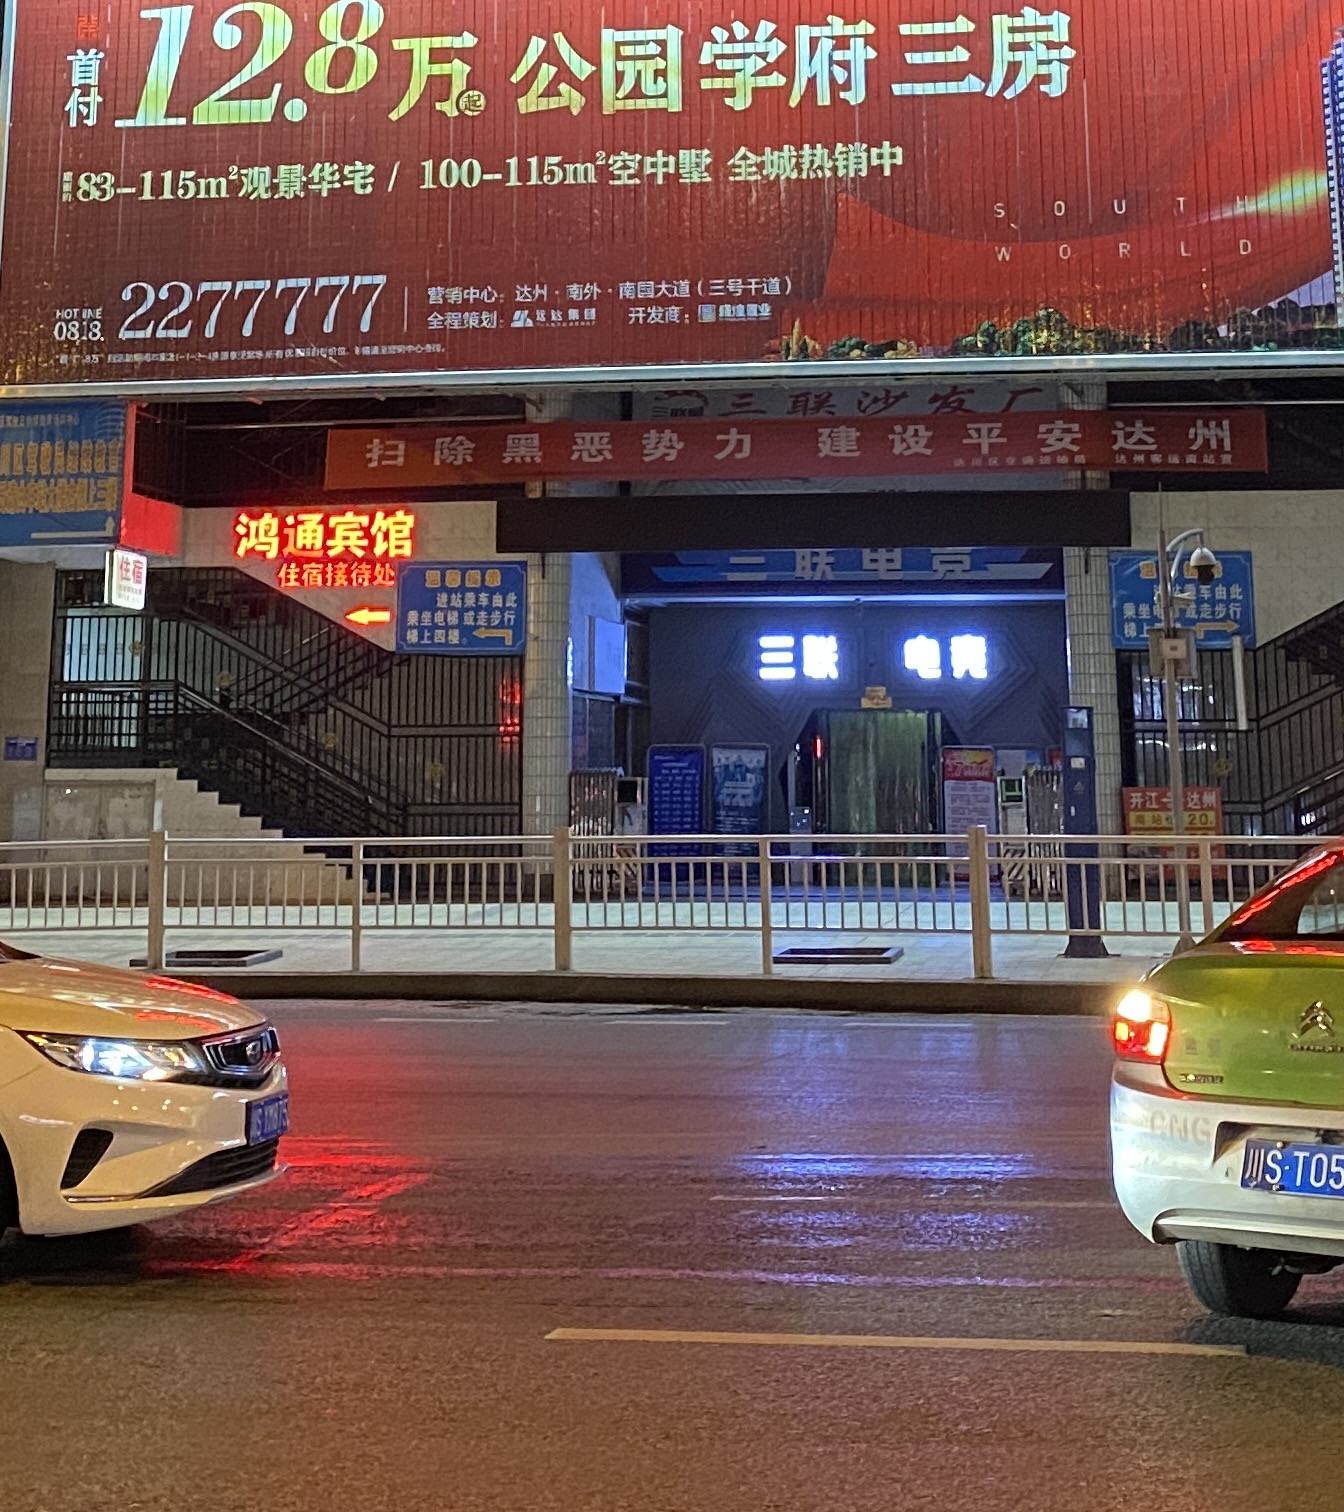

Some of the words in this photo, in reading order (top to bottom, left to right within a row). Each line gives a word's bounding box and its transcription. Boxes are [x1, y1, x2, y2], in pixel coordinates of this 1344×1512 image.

[509, 6, 1077, 116] 公园学府三房
[64, 48, 105, 128] 首付
[727, 140, 904, 184] 全城热销中
[996, 238, 1253, 262] WORLD
[118, 274, 387, 340] 2277777
[364, 426, 754, 469] 扫除黑恶势力
[817, 418, 1232, 459] 建设平安达州
[235, 509, 415, 559] 鸿通宾馆
[278, 562, 396, 588] 住宿接待处
[437, 592, 518, 608] 进站乘车由此
[759, 634, 839, 680] 三联
